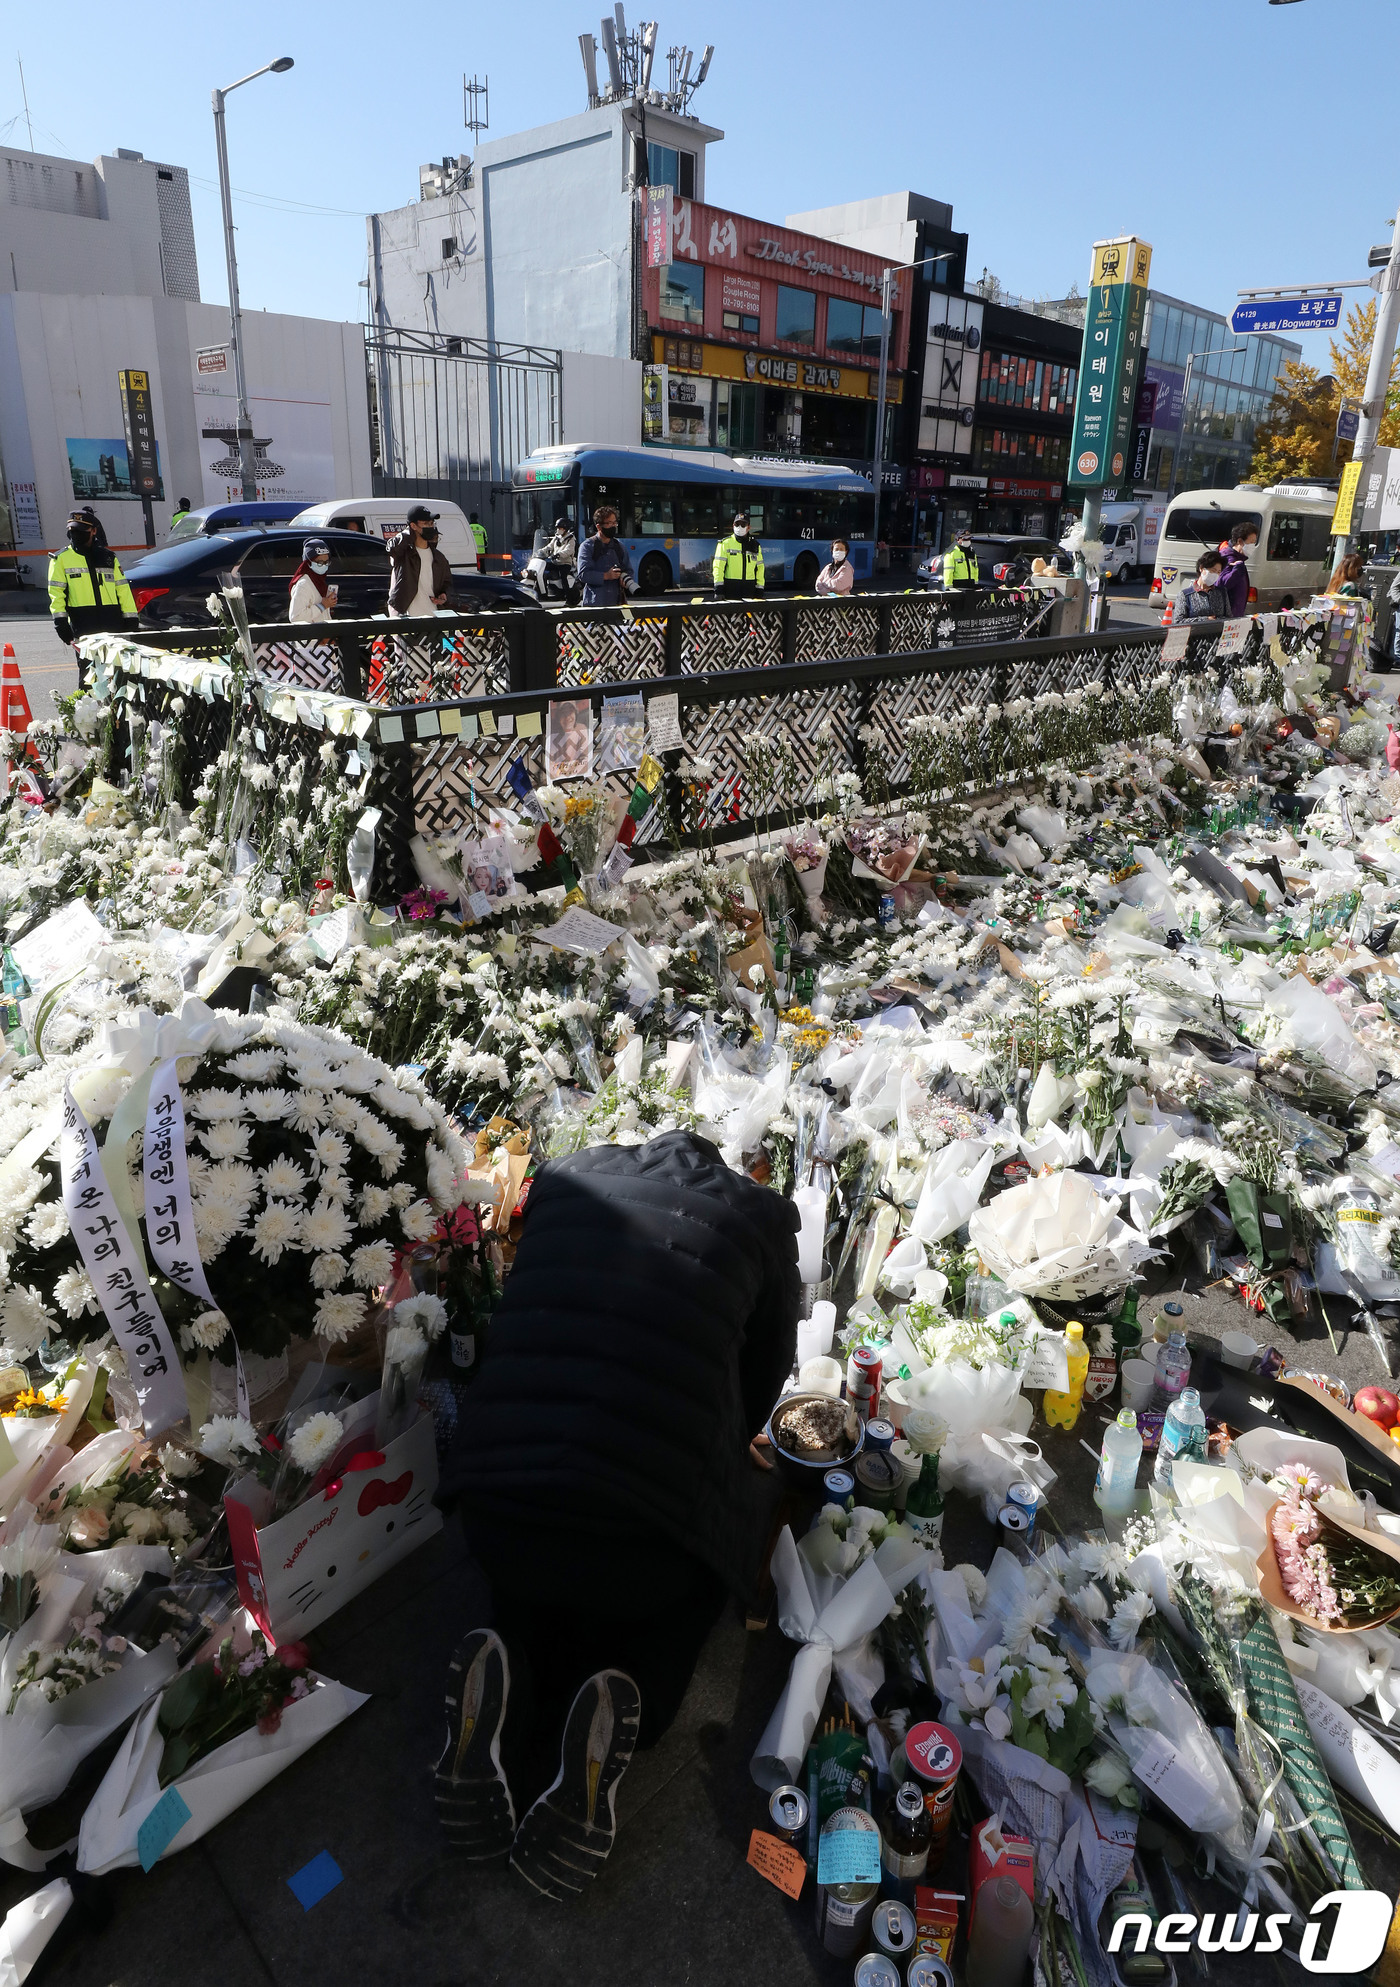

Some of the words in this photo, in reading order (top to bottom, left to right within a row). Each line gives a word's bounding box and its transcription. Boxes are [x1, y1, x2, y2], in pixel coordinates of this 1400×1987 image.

[723, 285, 743, 297] Couple
[744, 290, 760, 301] Room
[1103, 288, 1110, 309] 1
[1298, 300, 1337, 315] 보광로
[759, 358, 798, 382] 이바돔
[803, 364, 841, 389] 감자탕
[941, 357, 962, 392] X
[1088, 328, 1109, 403] 이태원
[1122, 330, 1137, 404] 이태원
[136, 393, 144, 403] 4
[137, 413, 150, 452] 이태원
[1080, 459, 1096, 468] 630
[1133, 430, 1146, 479] ALPEDO
[599, 485, 607, 493] 32
[865, 470, 902, 485] CFFEE
[800, 528, 816, 540] 421
[148, 1094, 177, 1185] 다음생엔
[74, 1188, 105, 1210] 온
[152, 1195, 181, 1247] 너의
[84, 1215, 121, 1262] 나의
[169, 1261, 194, 1284] 손
[106, 1267, 169, 1378] 친구들이여
[283, 1538, 309, 1570] Hello
[307, 1514, 335, 1539] Kitty
[1279, 1723, 1304, 1736] MARKET
[914, 1731, 944, 1758] PRINGLES
